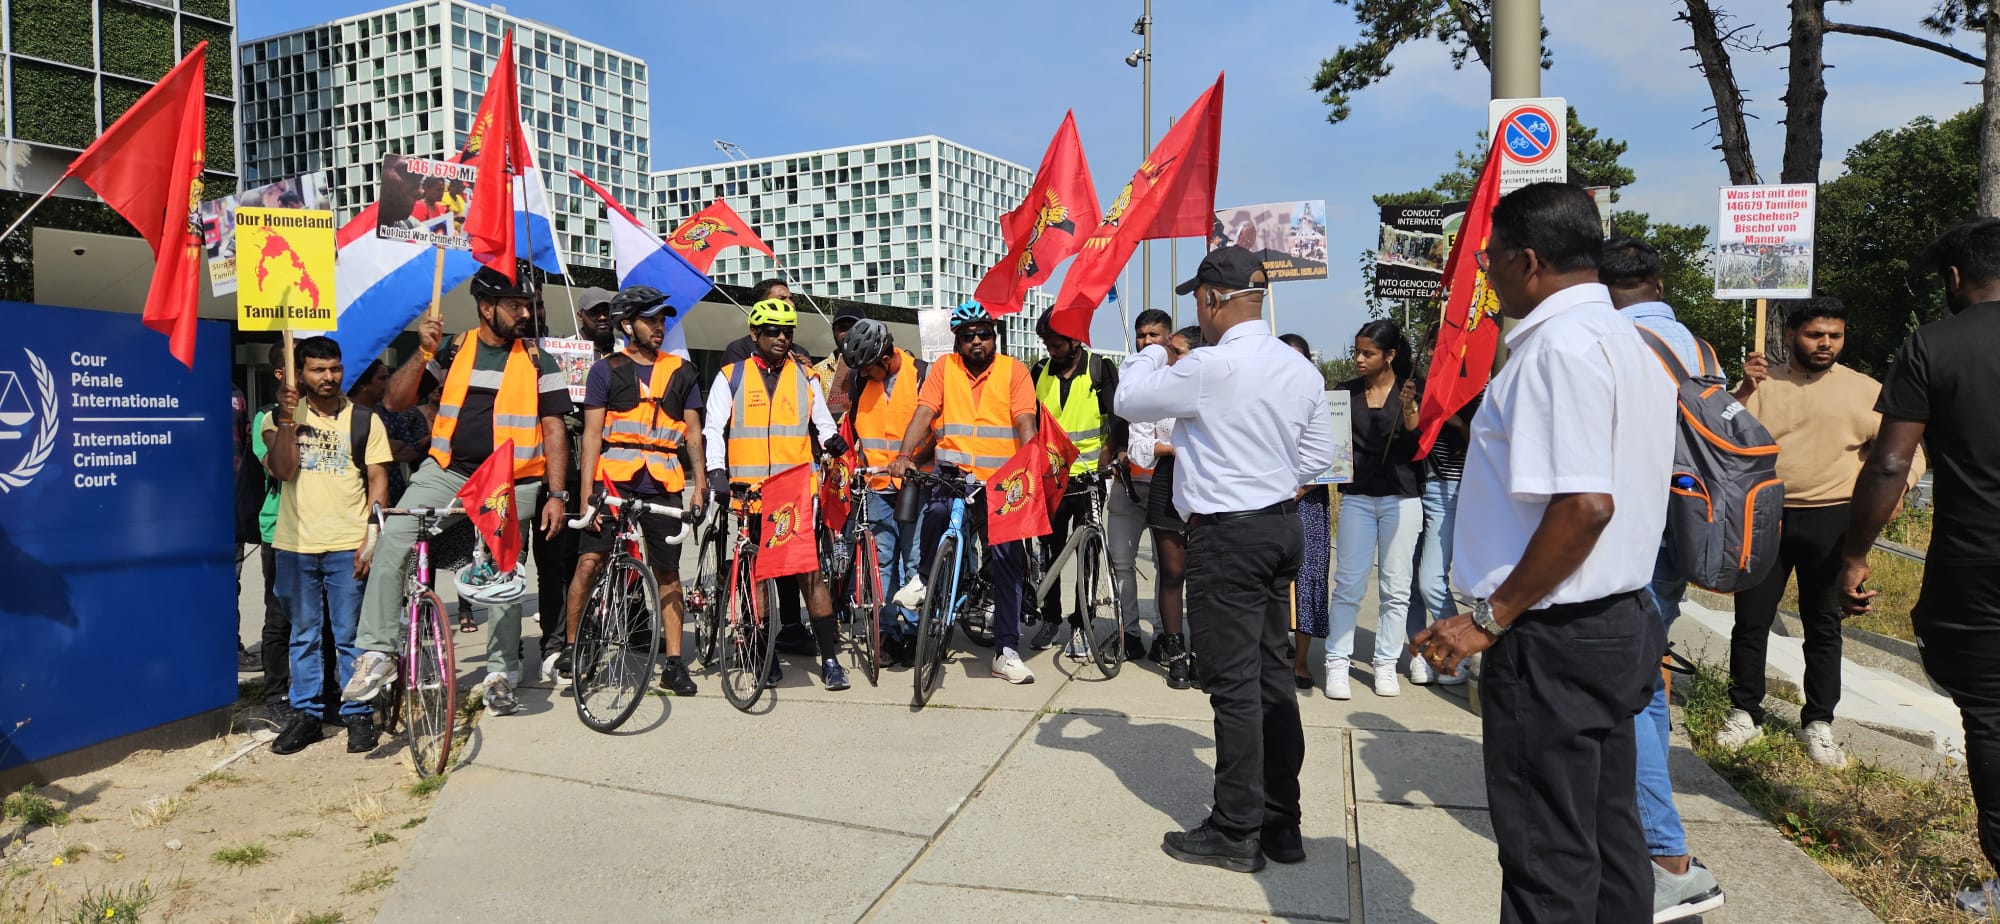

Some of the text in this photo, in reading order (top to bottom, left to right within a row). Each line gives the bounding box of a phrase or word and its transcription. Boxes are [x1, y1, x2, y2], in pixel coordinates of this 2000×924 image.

[1535, 176, 1563, 184] interdit
[1727, 188, 1807, 199] Was ist mit den
[1727, 200, 1807, 211] 146679 Tamilen
[1401, 209, 1440, 217] CONDUCT
[1733, 211, 1799, 223] geschehen?
[236, 213, 333, 229] Our Homeland
[381, 225, 394, 237] Not
[395, 227, 411, 239] Just
[412, 231, 428, 241] War
[1735, 223, 1796, 233] Bischof von
[1745, 235, 1785, 244] Mannar
[1379, 279, 1398, 287] INTO
[1380, 288, 1415, 296] AGAINST
[244, 305, 331, 319] Tamil Eelam
[544, 340, 591, 350] DELAYED
[70, 351, 107, 367] Cour
[71, 371, 124, 388] Pénale
[71, 393, 179, 408] Internationale
[73, 430, 172, 447] International
[73, 451, 137, 467] Criminal
[74, 472, 117, 488] Court
[1090, 490, 1100, 525] GIANT
